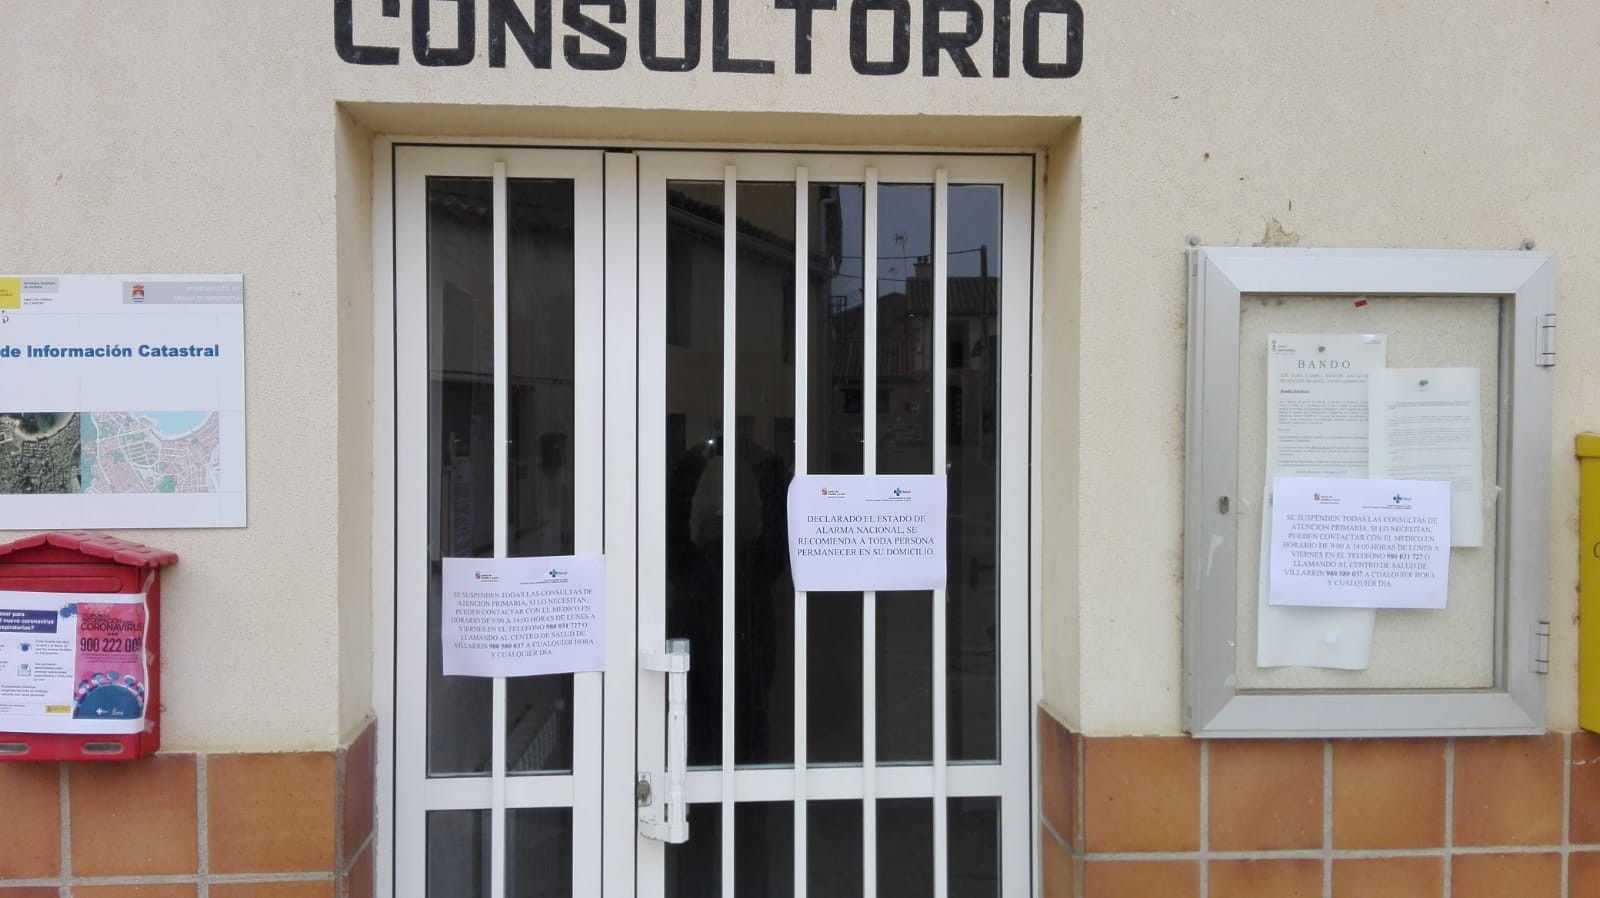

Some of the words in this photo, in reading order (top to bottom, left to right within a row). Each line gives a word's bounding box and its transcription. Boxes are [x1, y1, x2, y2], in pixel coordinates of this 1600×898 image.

[333, 0, 1083, 79] CONSULTORIO
[0, 345, 21, 357] de
[27, 345, 131, 357] Información
[138, 344, 218, 357] Catastral
[1298, 360, 1351, 368] BANDO
[1371, 571, 1413, 579] CUALQUIER
[1335, 580, 1376, 588] CUALQUIER
[80, 637, 99, 652] 900
[103, 638, 122, 652] 222
[532, 640, 572, 648] CUALQUIER
